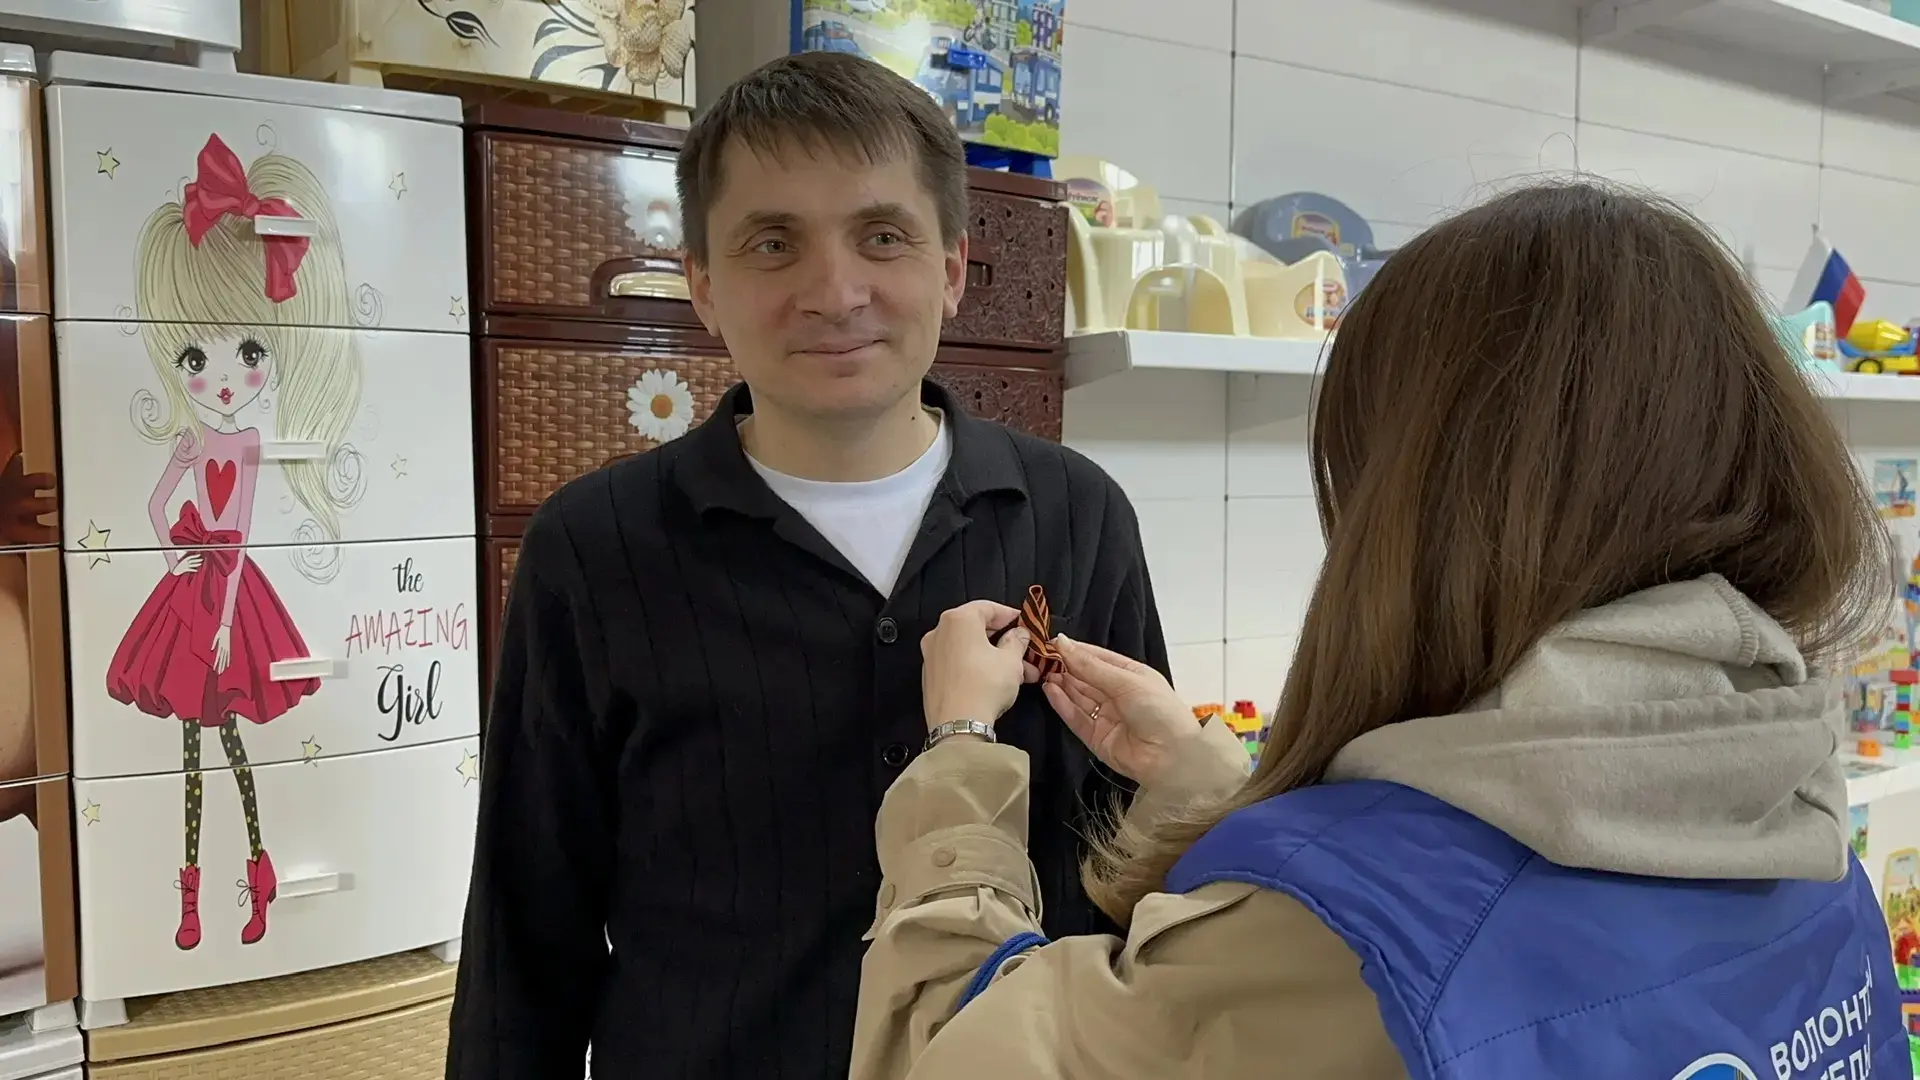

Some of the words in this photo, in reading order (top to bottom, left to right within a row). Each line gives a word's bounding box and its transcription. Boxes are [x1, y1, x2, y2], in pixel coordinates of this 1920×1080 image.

[392, 557, 424, 593] the
[345, 603, 468, 658] AMAZING
[376, 660, 443, 741] Girl
[1770, 954, 1873, 1080] ВОЛОНТ
